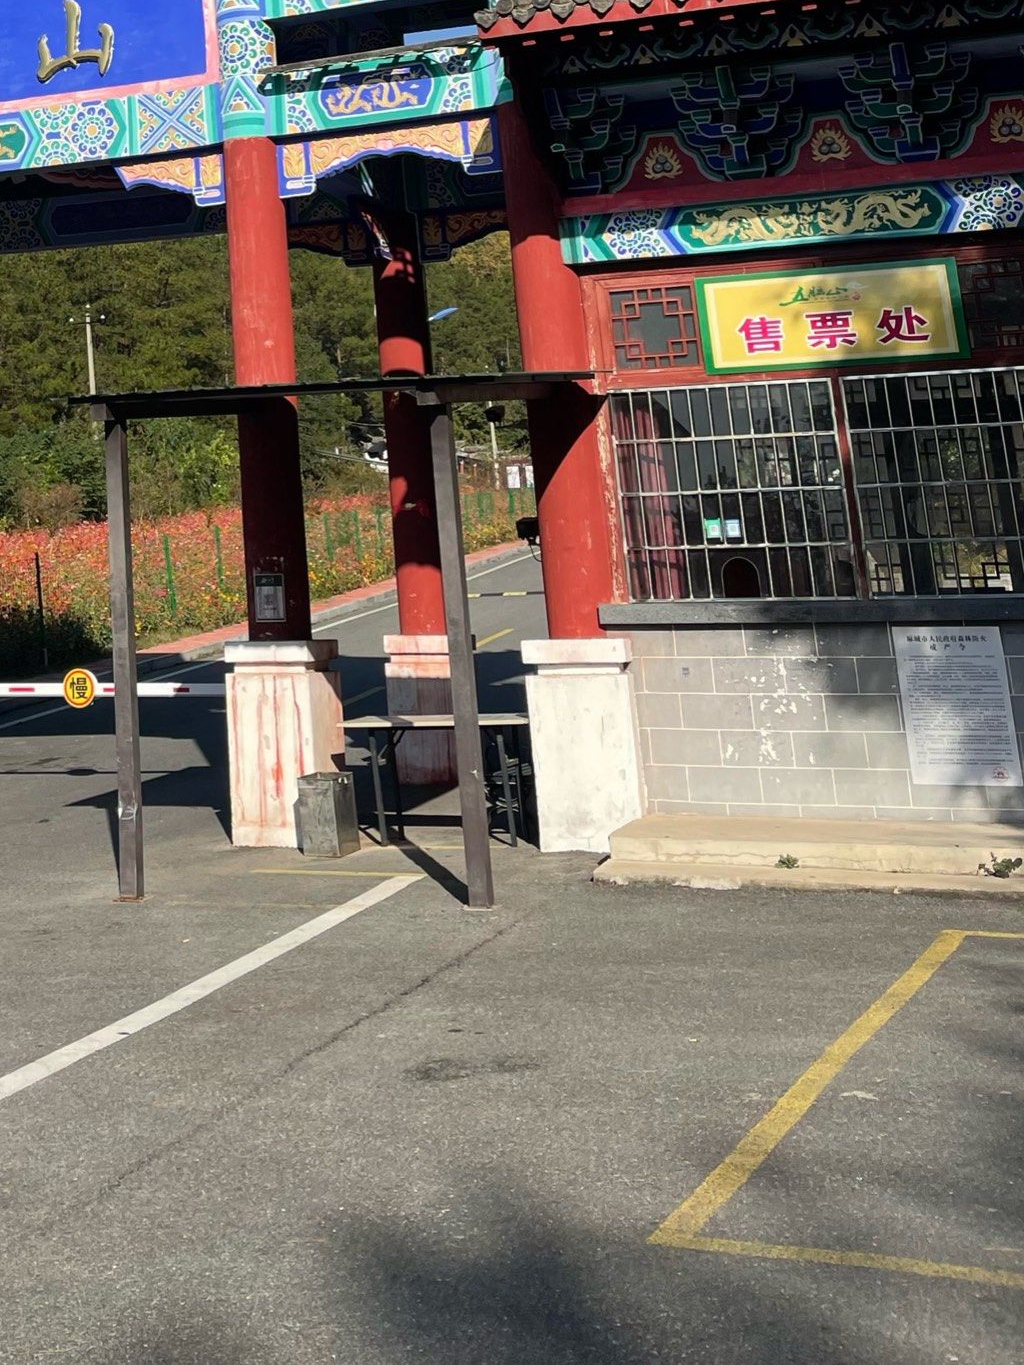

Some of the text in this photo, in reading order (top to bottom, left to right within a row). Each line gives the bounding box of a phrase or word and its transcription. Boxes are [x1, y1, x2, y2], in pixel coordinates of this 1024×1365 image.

[738, 306, 931, 353] 售票处
[69, 676, 87, 699] 慢
